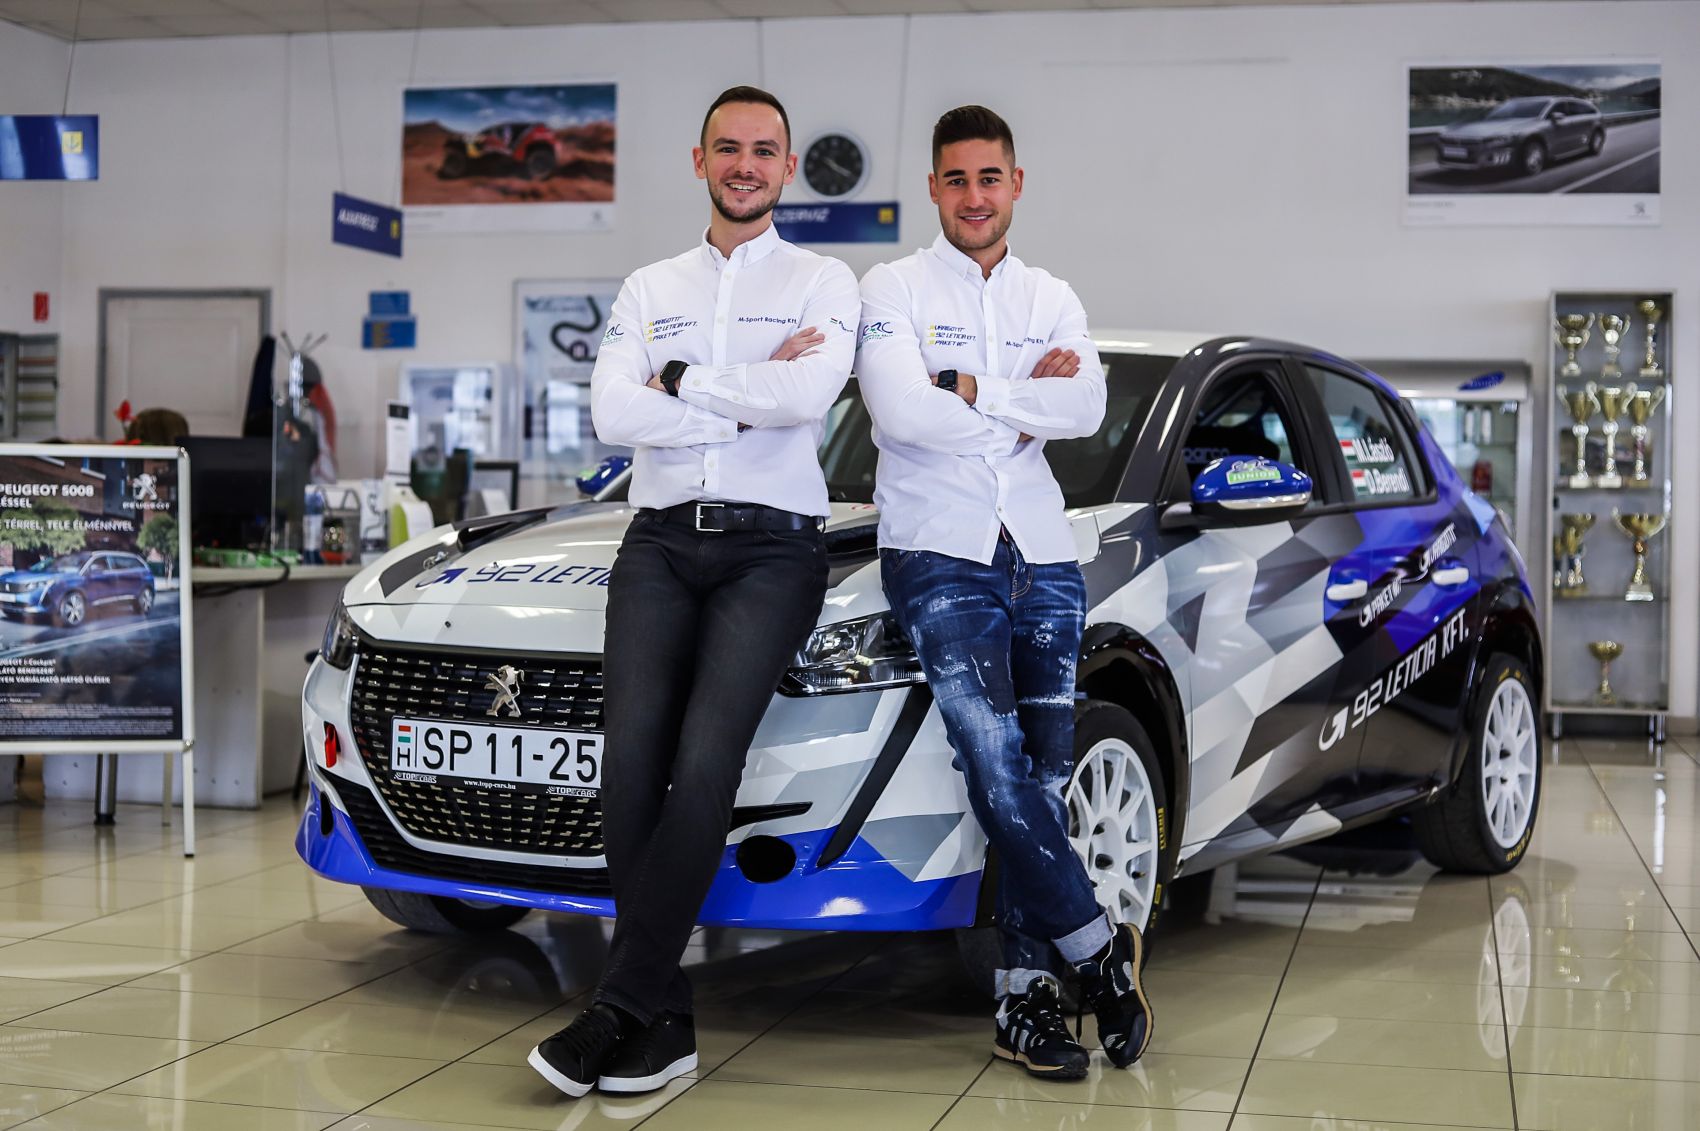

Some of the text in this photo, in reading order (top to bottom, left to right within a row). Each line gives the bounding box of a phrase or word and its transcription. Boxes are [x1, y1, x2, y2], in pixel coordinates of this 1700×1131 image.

[764, 317, 786, 325] Racing
[1232, 470, 1276, 480] JUNIOR
[0, 484, 59, 496] PEUGEOT
[0, 495, 32, 508] ÉSSEL
[46, 519, 71, 530] TELE
[1352, 608, 1469, 728] 92 LETICIA KFT.
[396, 727, 597, 783] H SP 11-25
